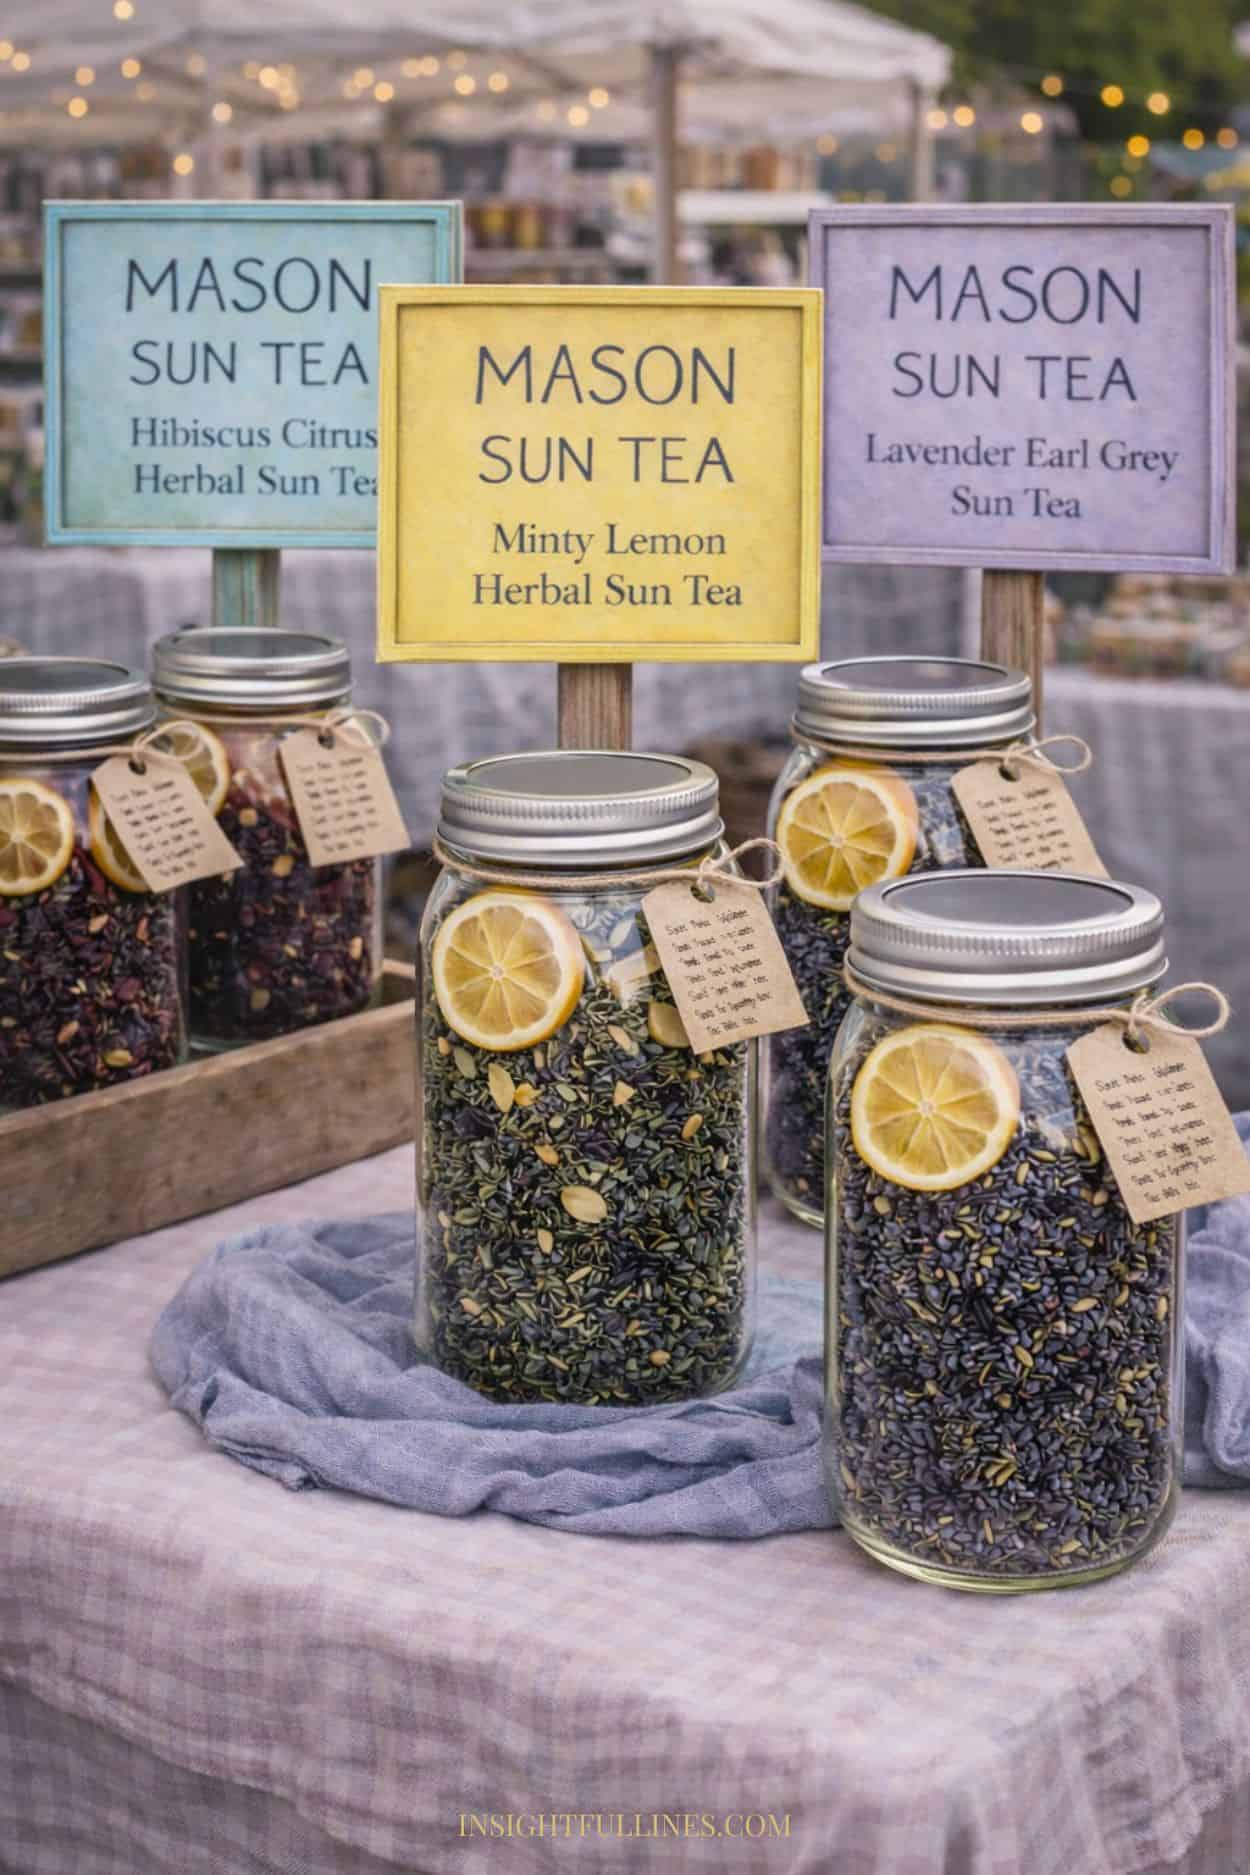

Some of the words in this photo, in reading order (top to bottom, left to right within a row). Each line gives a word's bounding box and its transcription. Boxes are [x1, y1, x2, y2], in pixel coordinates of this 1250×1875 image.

[125, 256, 373, 314] MASON
[888, 263, 1142, 326] MASON
[129, 339, 237, 387] SUN
[259, 340, 369, 387] TEA
[475, 343, 736, 407] MASON
[892, 351, 1002, 400] SUN
[1024, 354, 1139, 403] TEA
[131, 416, 271, 448] Hibiscus
[281, 417, 379, 450] Citrus
[865, 432, 1016, 468] Lavender
[1025, 436, 1090, 470] Earl
[1099, 439, 1180, 484] Grey
[133, 462, 244, 496] Herbal
[257, 464, 320, 497] Sun
[478, 434, 594, 486] SUN
[617, 435, 735, 486] TEA
[951, 485, 1015, 518] Sun
[1022, 487, 1082, 520] Tea
[493, 521, 594, 566] Minty
[604, 522, 727, 557] Lemon
[472, 570, 594, 607] Herbal
[603, 572, 673, 607] Sun
[682, 573, 744, 608] Tea
